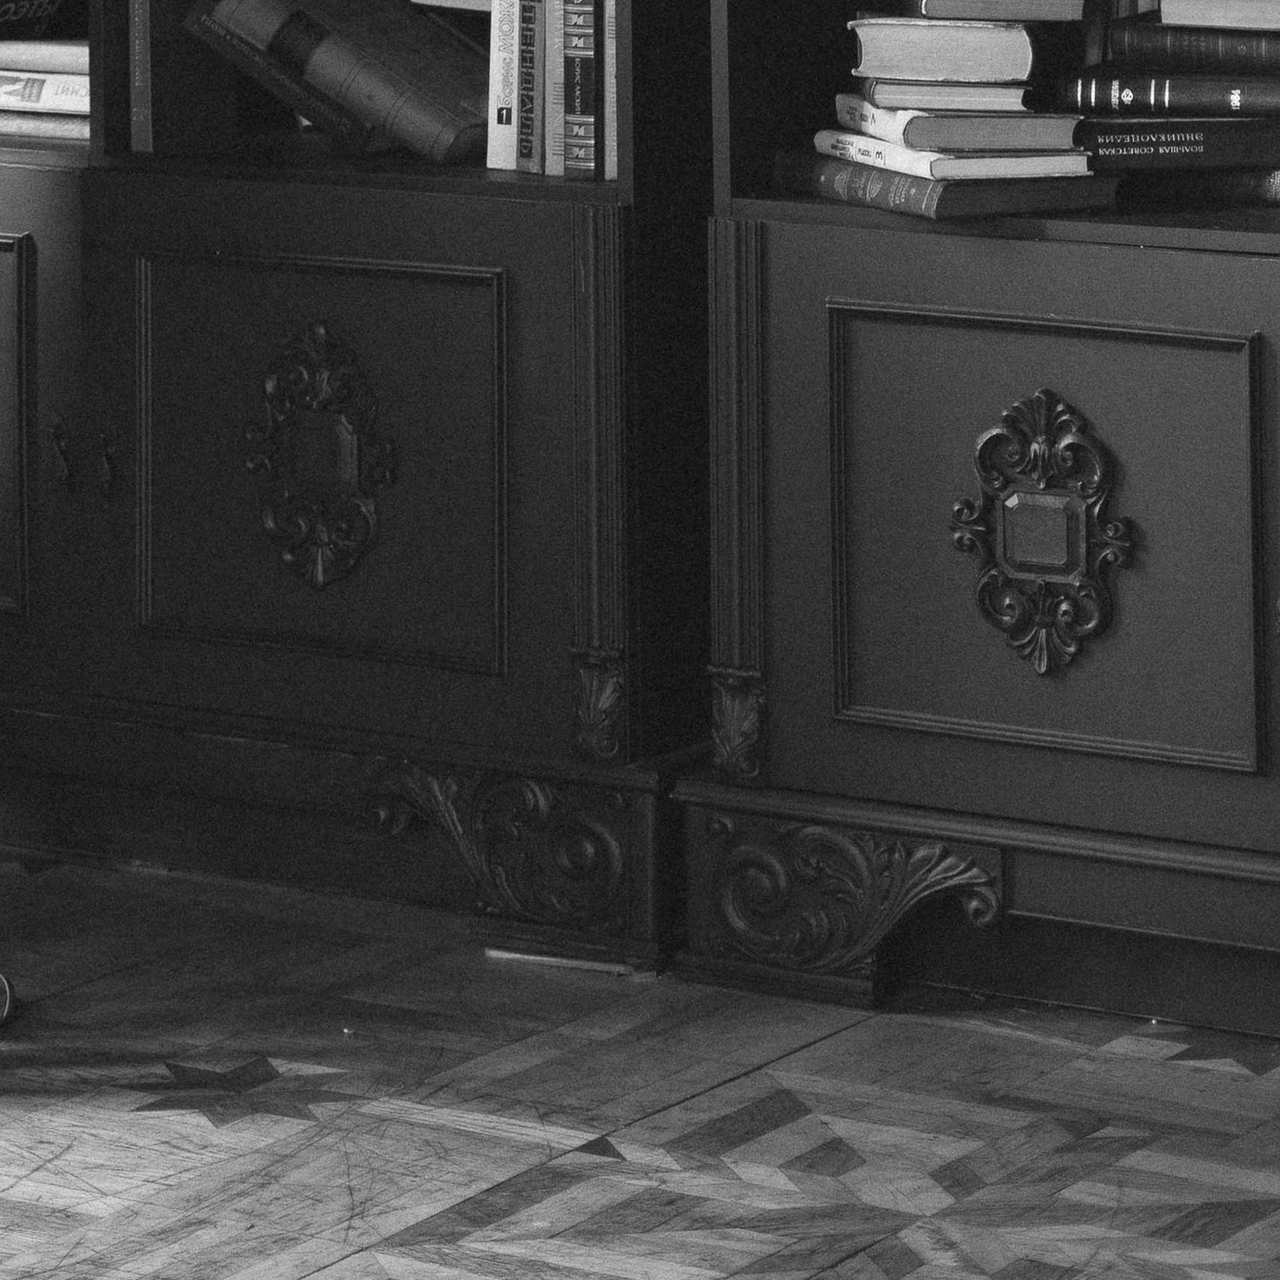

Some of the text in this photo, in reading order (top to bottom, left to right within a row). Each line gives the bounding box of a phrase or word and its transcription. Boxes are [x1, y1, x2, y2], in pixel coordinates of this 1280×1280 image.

[1229, 88, 1241, 110] 1984
[1097, 131, 1203, 144] ЭНЦИКЛОПЕДИЯ
[1098, 144, 1203, 155] БОЛЬШАЯ СОВЕТСКАЯ
